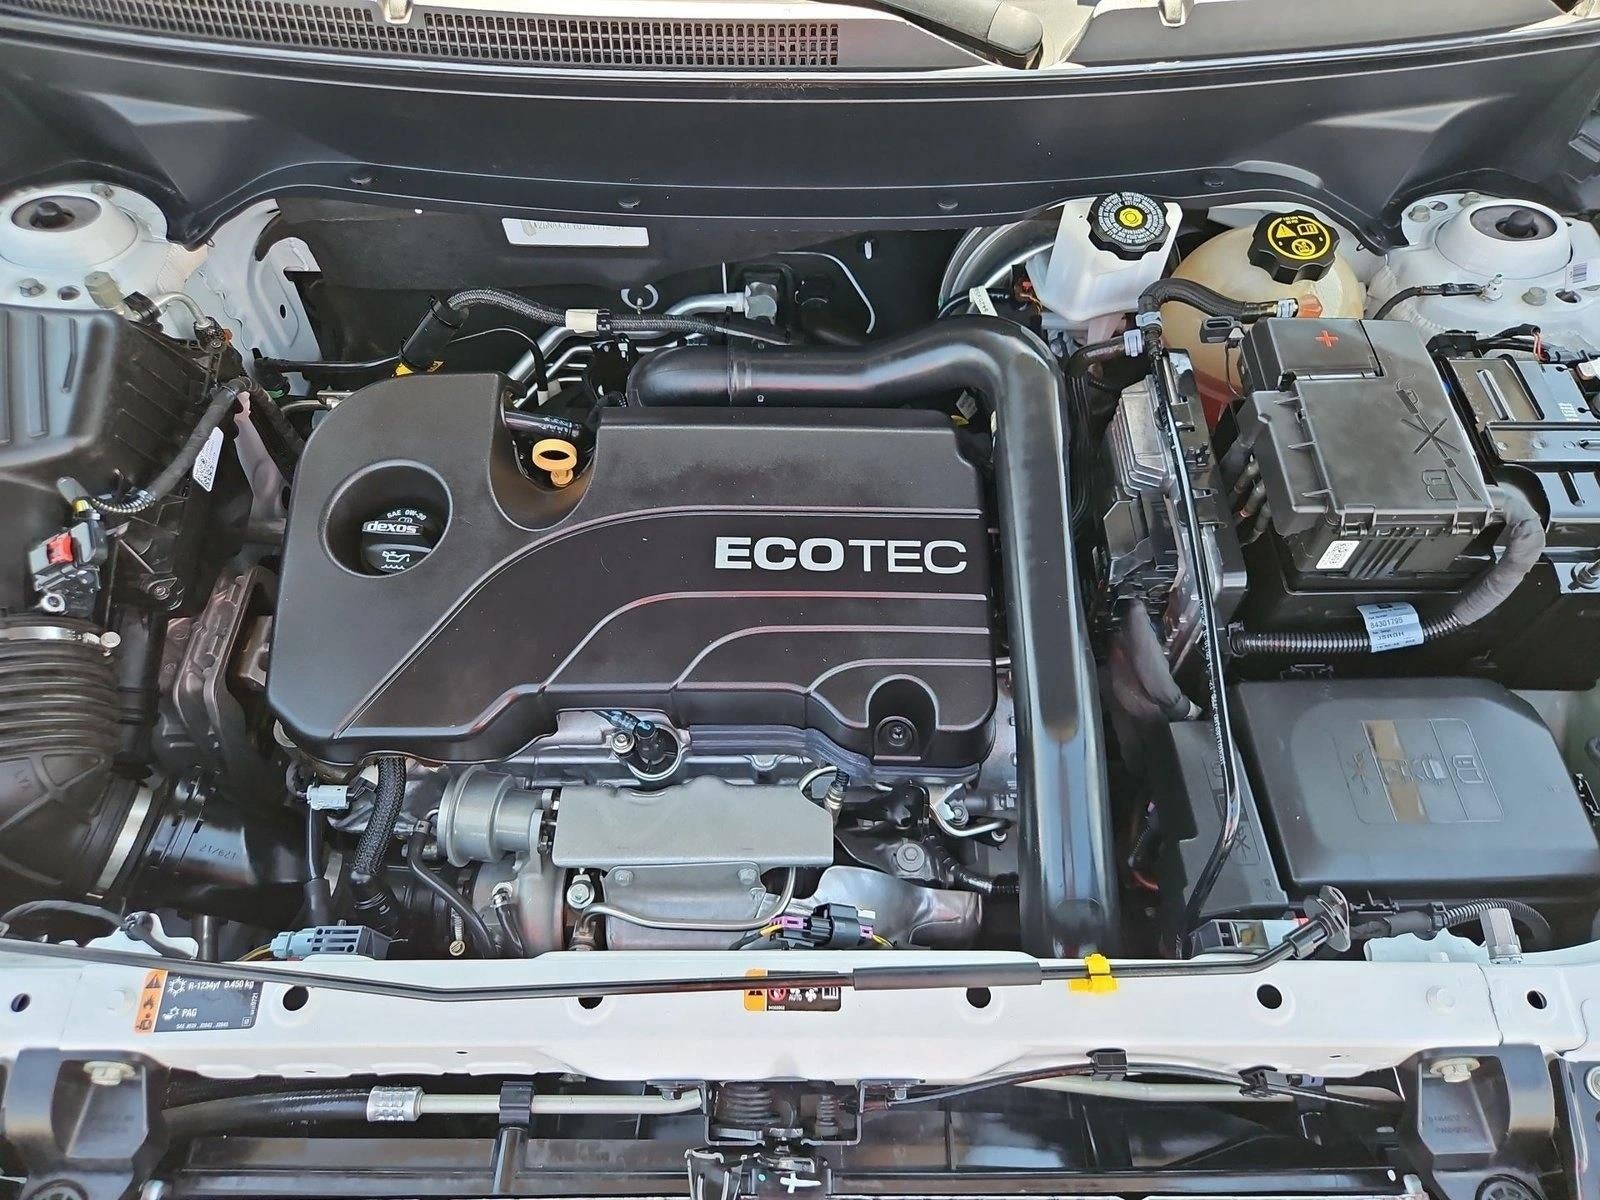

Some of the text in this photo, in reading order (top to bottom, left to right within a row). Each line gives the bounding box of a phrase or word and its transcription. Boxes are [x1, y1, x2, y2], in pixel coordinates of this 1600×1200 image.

[387, 509, 401, 518] SAE
[366, 520, 419, 534] dexos
[715, 536, 967, 574] ECOTEC
[188, 980, 255, 991] R-1234yf 0.450 kg
[181, 1008, 198, 1018] PAG
